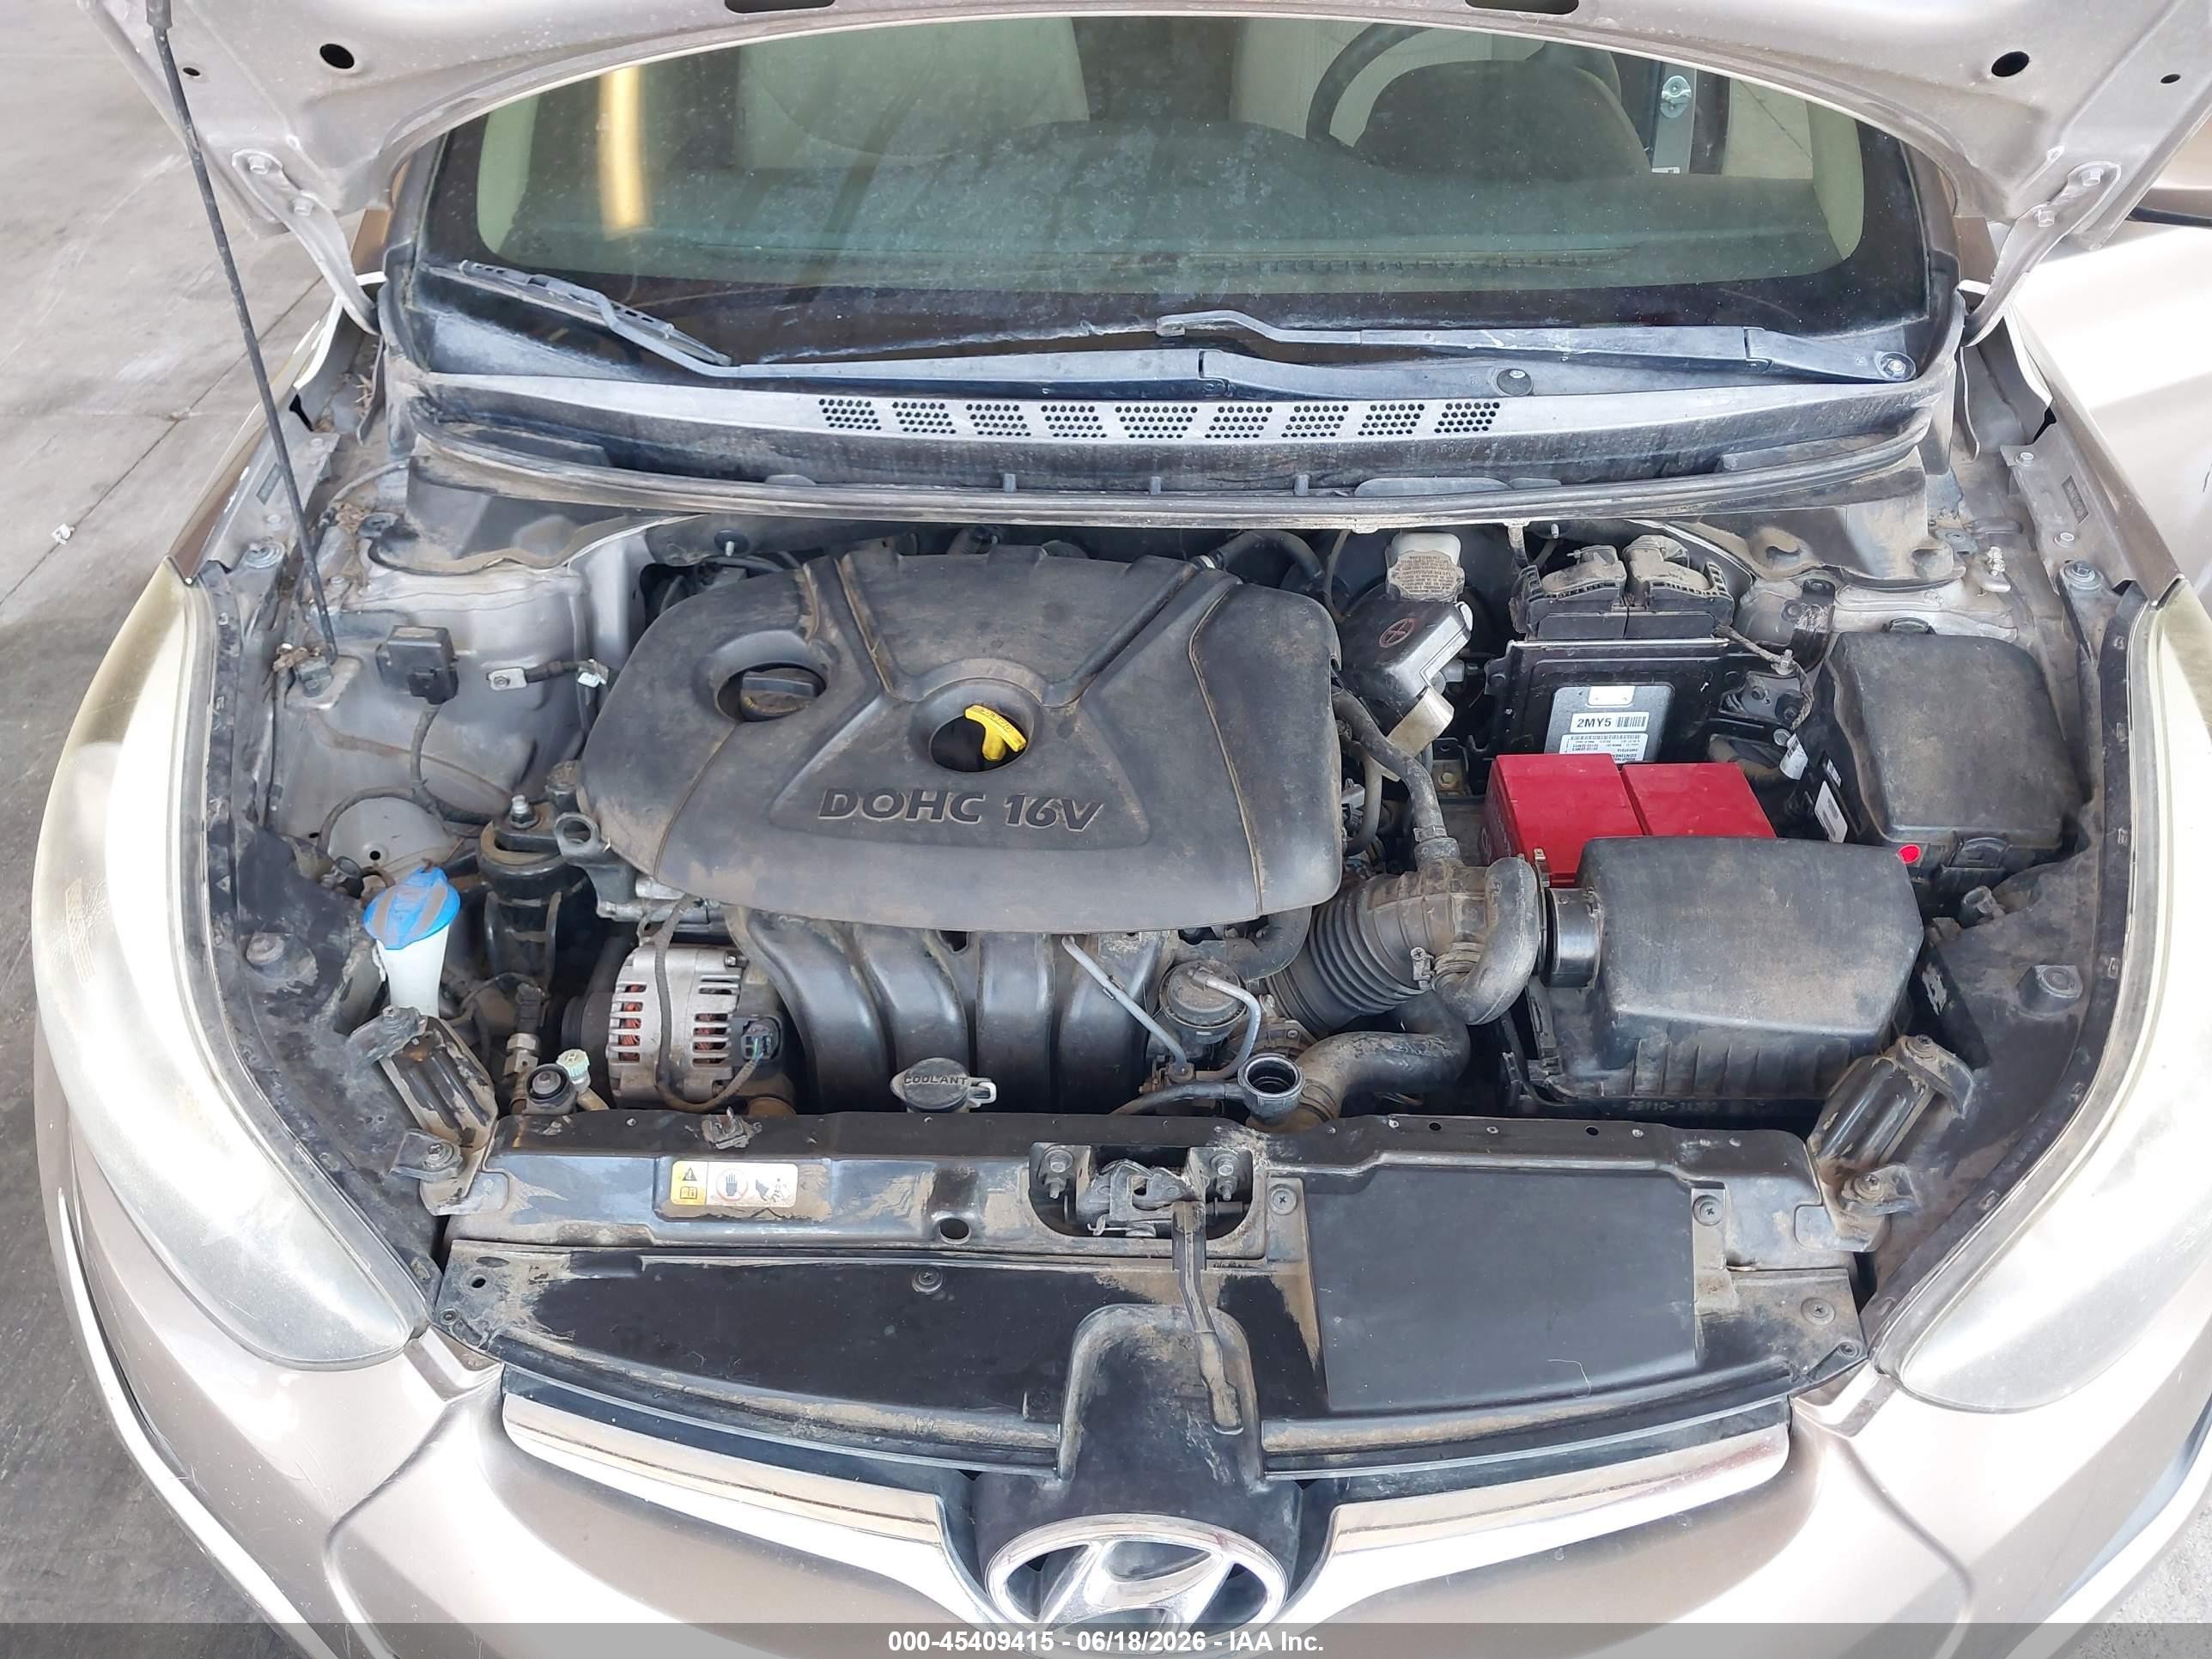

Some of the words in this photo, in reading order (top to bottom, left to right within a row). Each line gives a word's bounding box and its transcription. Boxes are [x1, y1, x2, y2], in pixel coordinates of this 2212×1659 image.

[1577, 718, 1612, 728] 2MY5
[817, 787, 986, 824] DOHC
[1003, 792, 1104, 833] 16V
[903, 1074, 968, 1085] COOLANT
